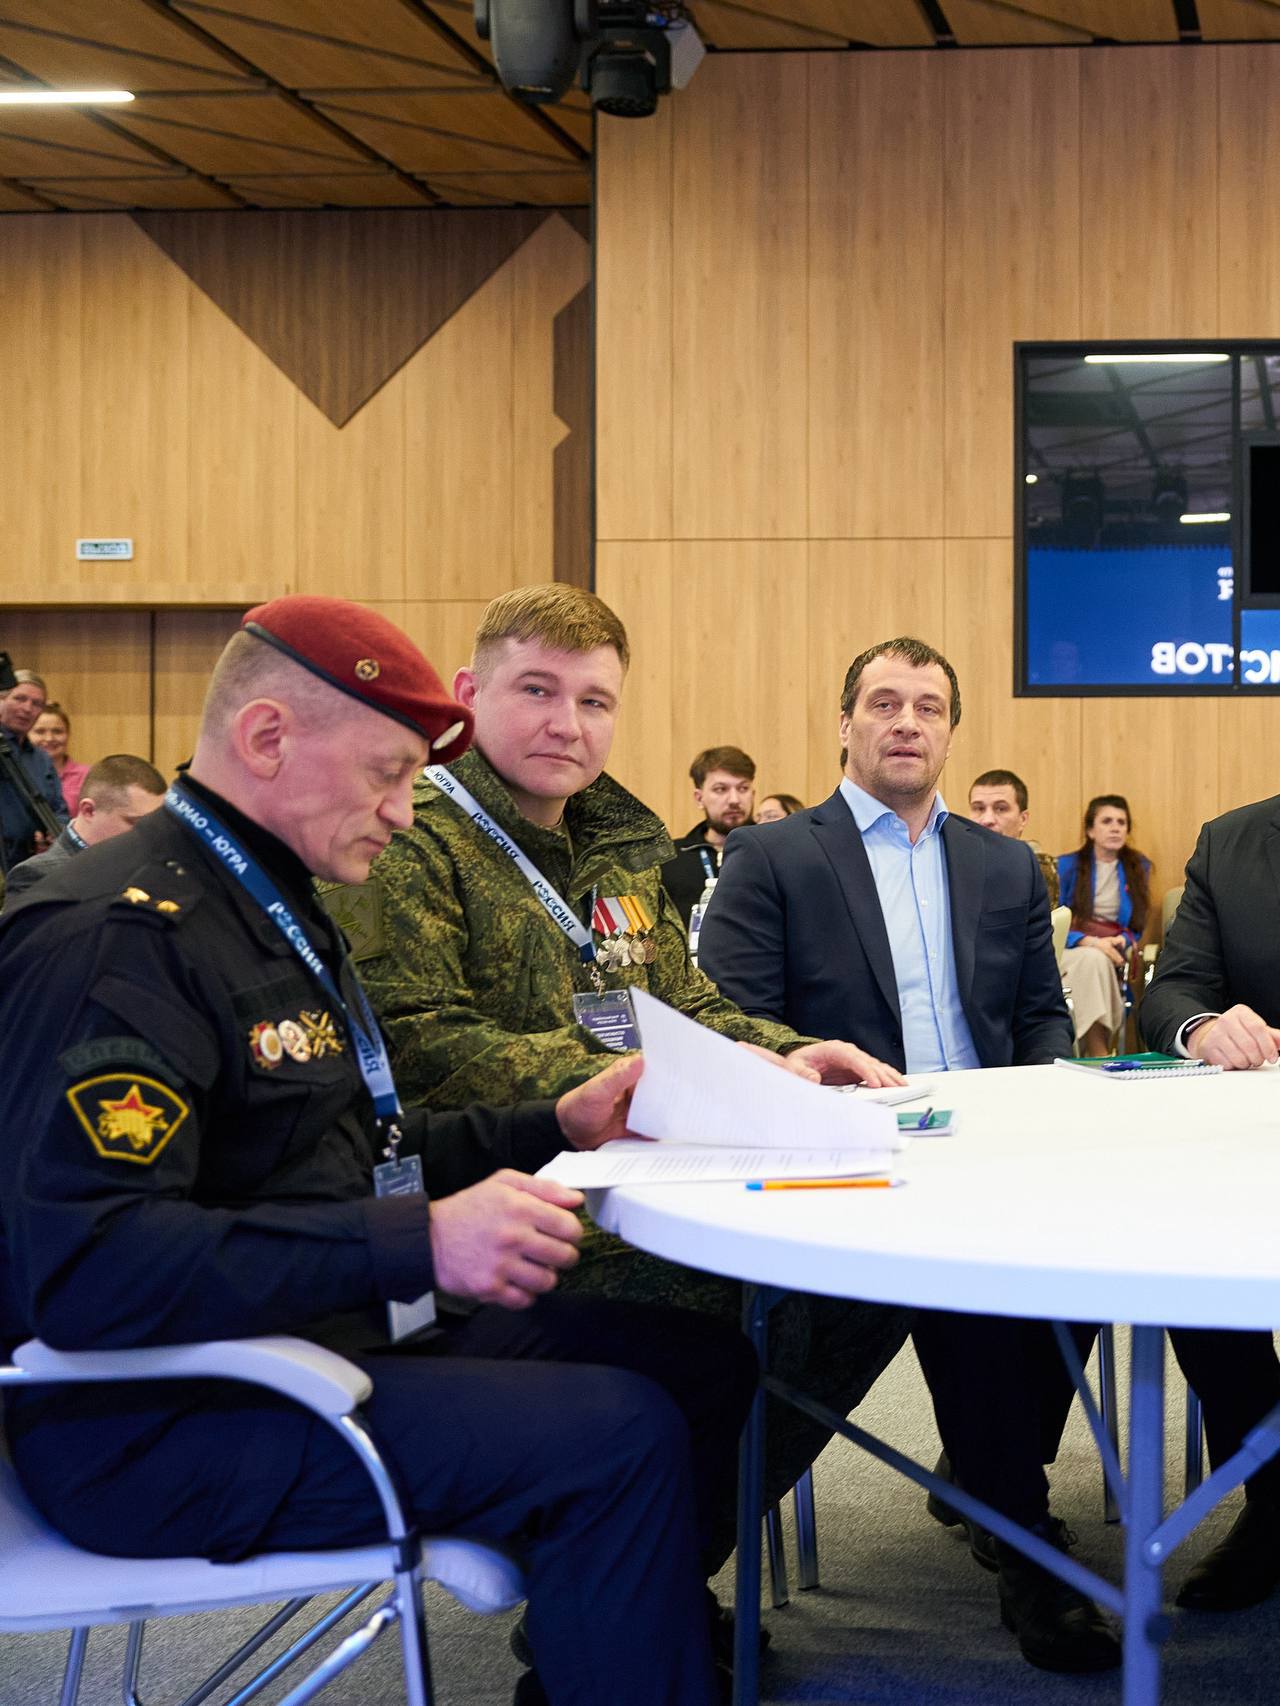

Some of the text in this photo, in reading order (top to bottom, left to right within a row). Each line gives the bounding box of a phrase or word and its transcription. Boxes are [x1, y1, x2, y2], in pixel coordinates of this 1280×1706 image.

[433, 770, 456, 795] ЮГРА
[212, 835, 248, 875] ЮГРА
[532, 880, 577, 933] РОССИЯ
